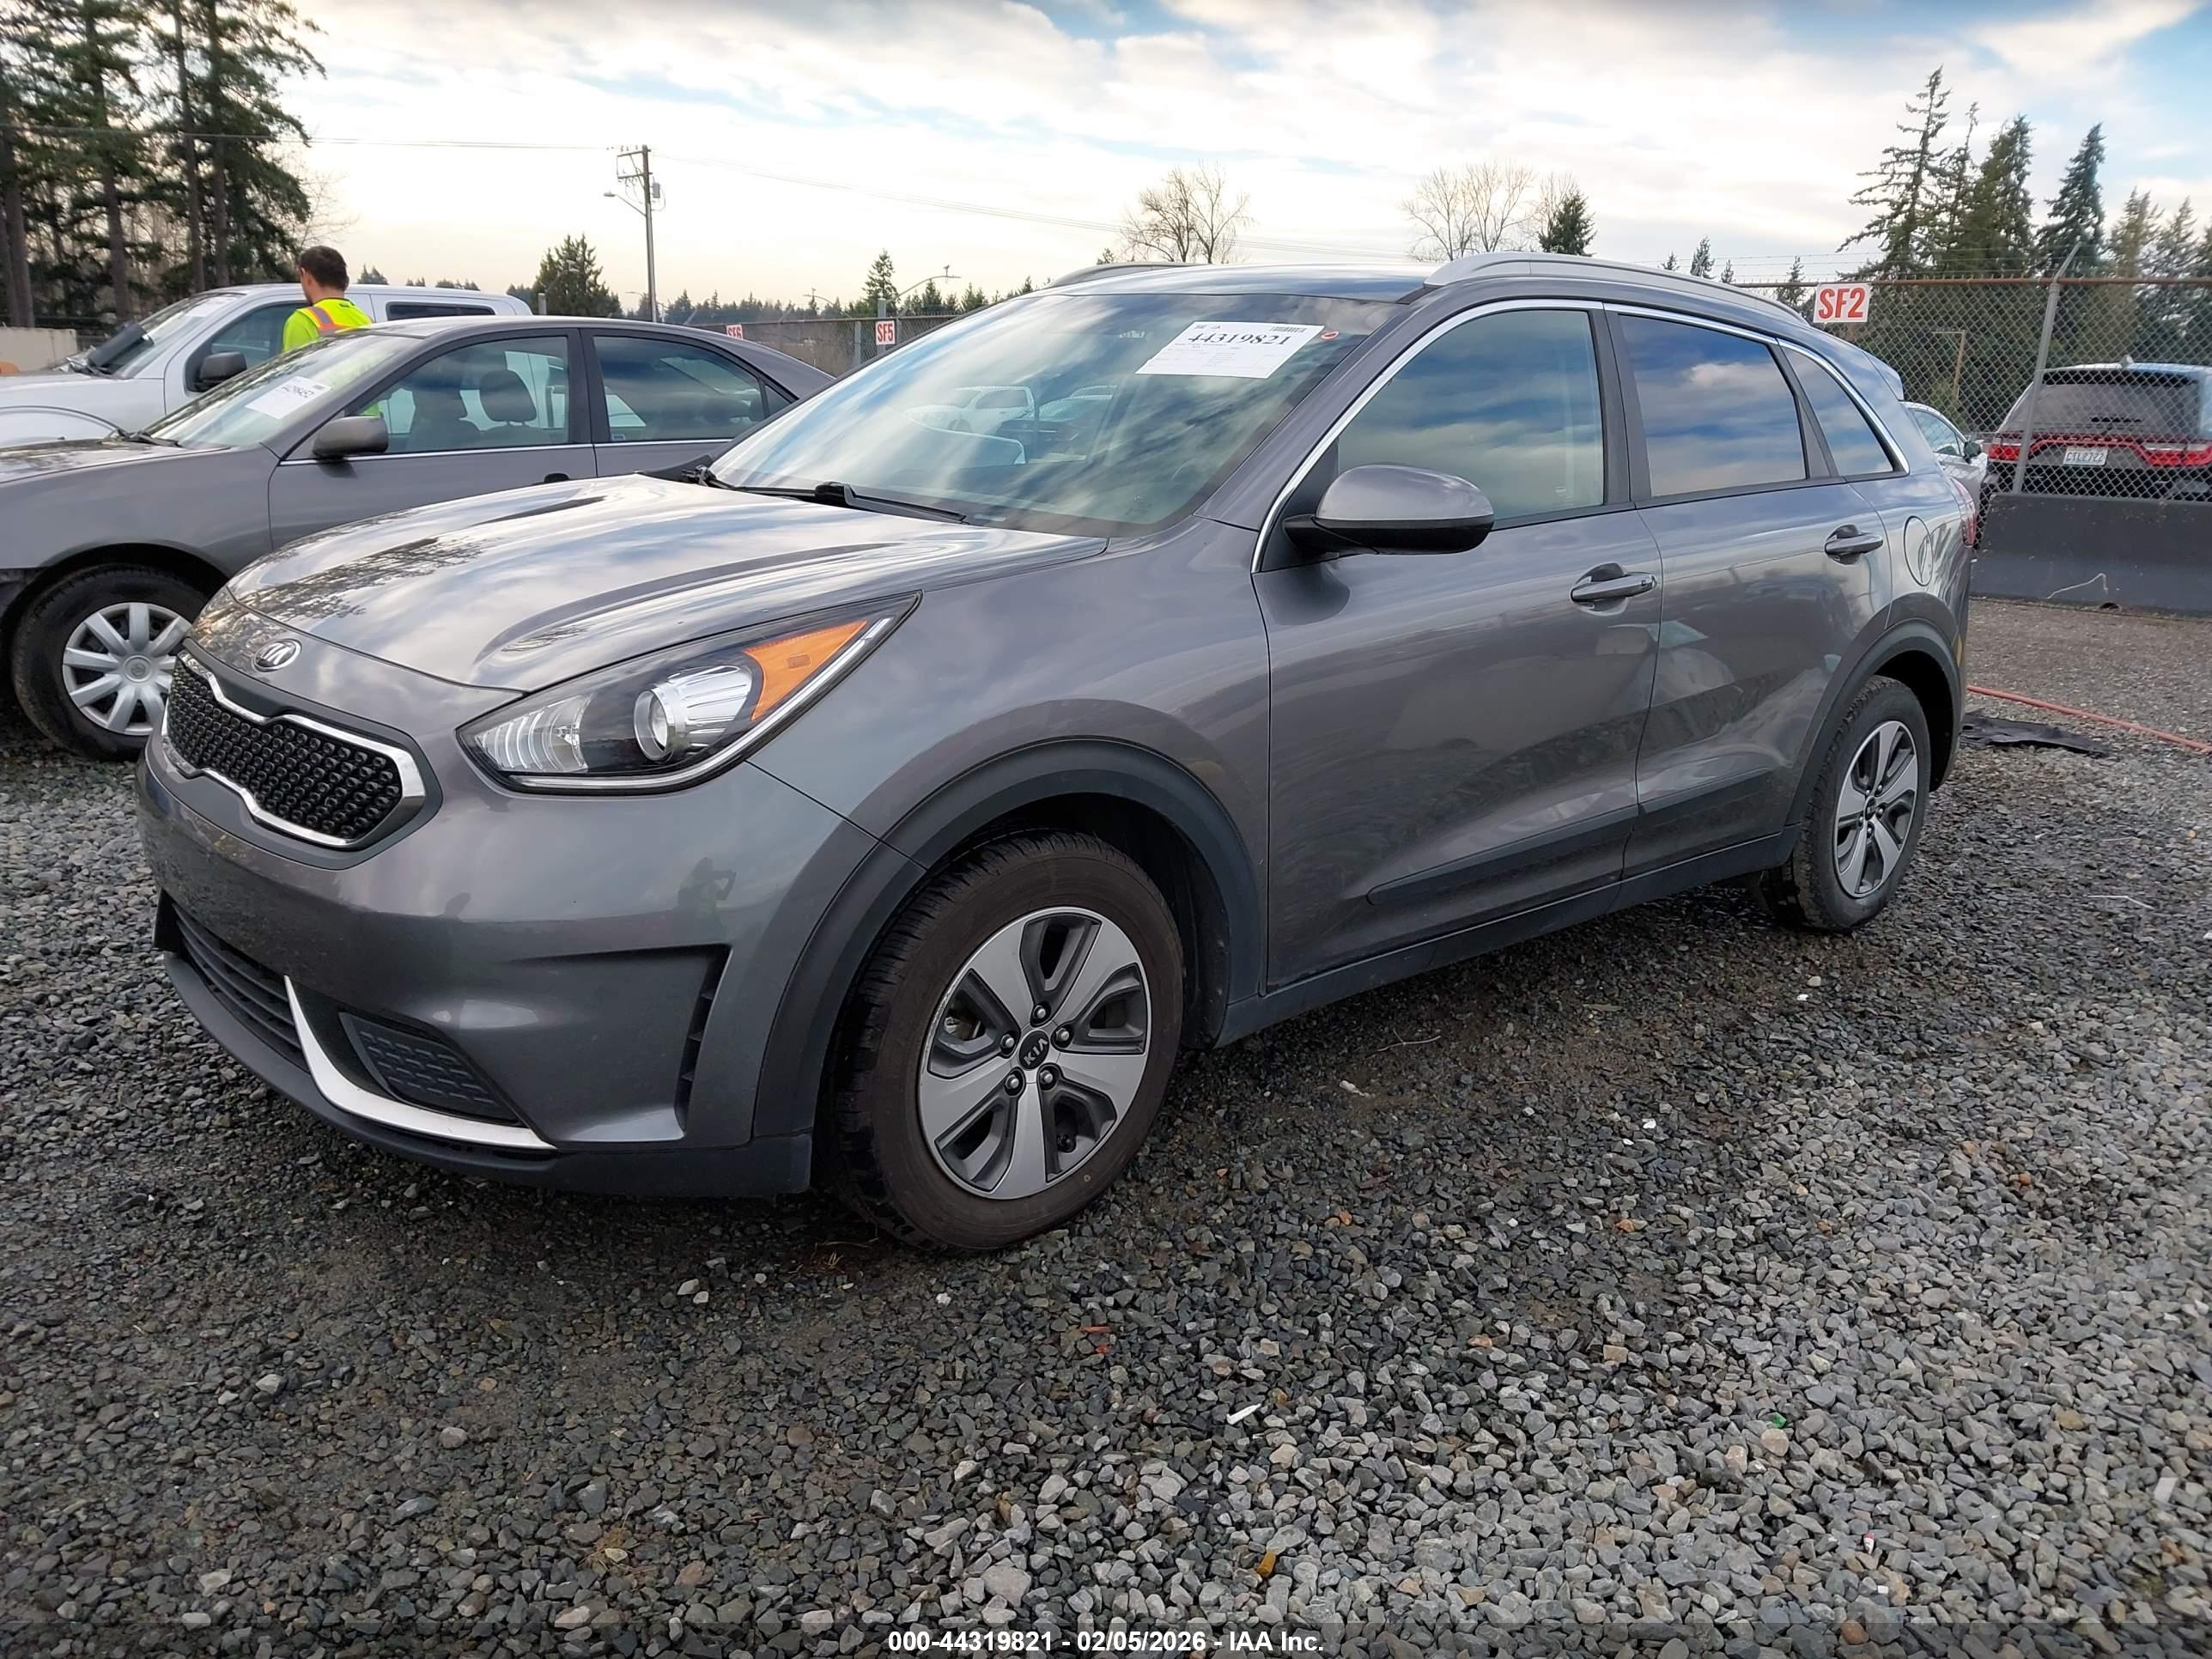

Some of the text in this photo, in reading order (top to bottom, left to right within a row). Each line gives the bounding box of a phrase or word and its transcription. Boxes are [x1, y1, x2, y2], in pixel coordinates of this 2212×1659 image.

[1818, 287, 1866, 319] SF2
[877, 323, 894, 342] SF5
[1188, 332, 1292, 345] 44319821
[1023, 1038, 1048, 1066] KIA
